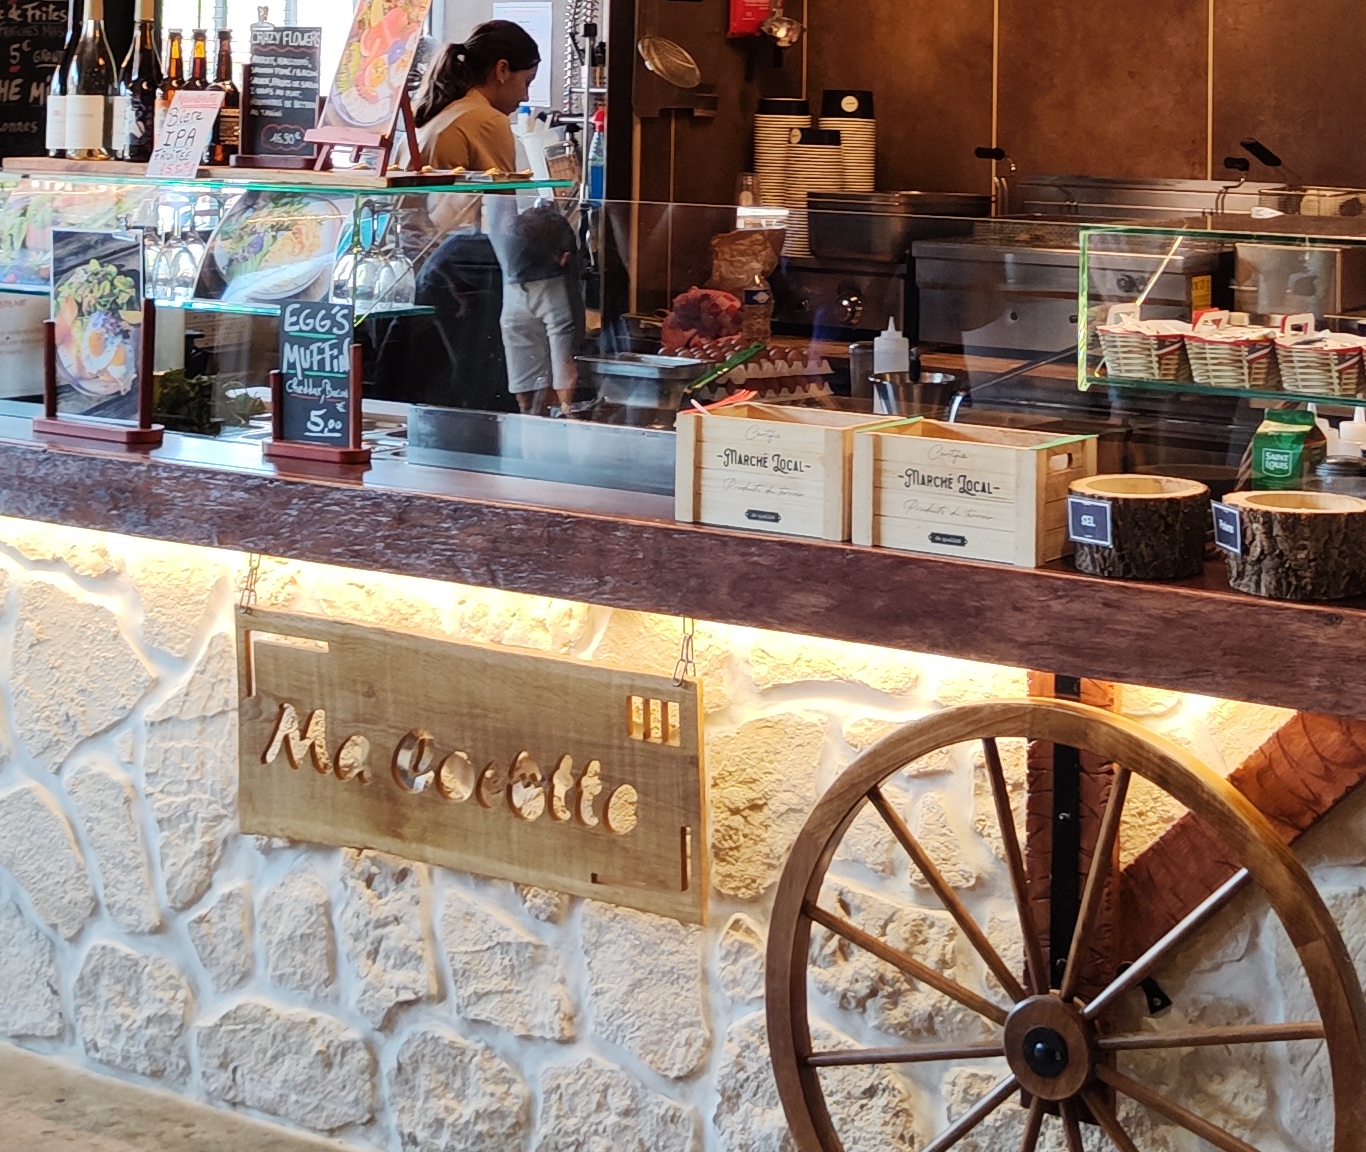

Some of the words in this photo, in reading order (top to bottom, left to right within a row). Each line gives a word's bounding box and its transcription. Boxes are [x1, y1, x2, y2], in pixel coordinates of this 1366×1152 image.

[8, 3, 23, 21] de
[25, 2, 67, 23] Frites
[163, 128, 197, 147] IPA
[284, 303, 350, 335] EGG'S
[1265, 451, 1290, 462] SAINT
[1265, 460, 1289, 470] LOUIS
[1081, 515, 1096, 527] SEL
[260, 702, 372, 786] Ma
[390, 727, 639, 836] Cocotte
